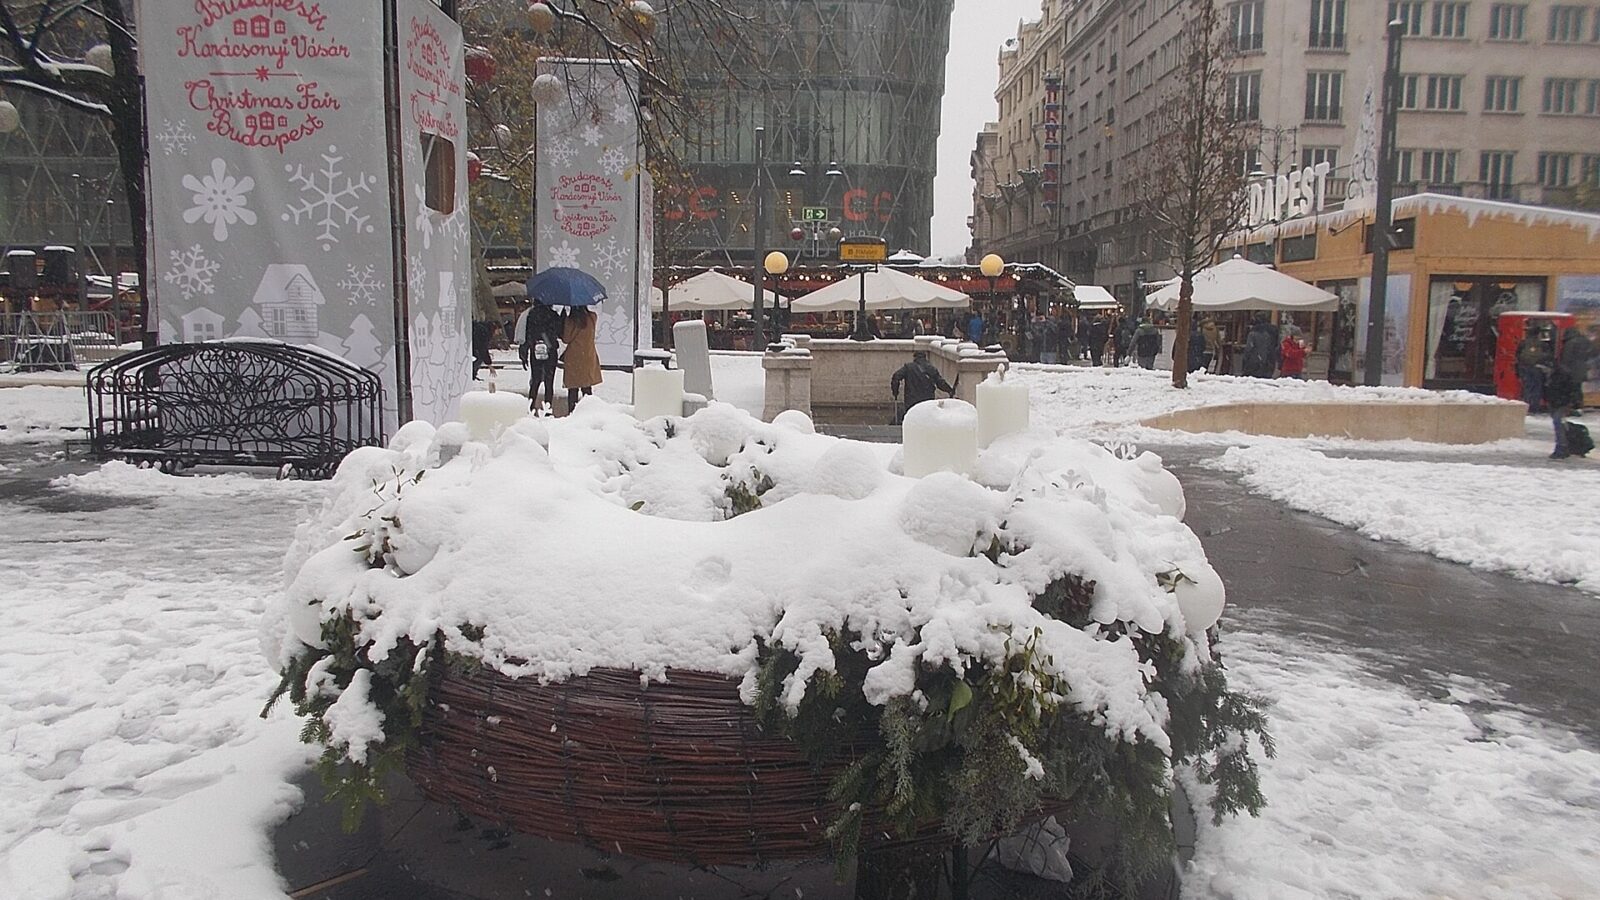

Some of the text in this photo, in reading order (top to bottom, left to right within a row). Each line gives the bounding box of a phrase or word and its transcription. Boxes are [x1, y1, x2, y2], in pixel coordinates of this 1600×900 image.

[177, 24, 350, 69] Karácsonyi Vásár
[184, 79, 341, 111] Christmas Fair
[207, 108, 324, 154] Budapest
[1226, 161, 1330, 227] DAPEST
[561, 221, 610, 240] Budapest
